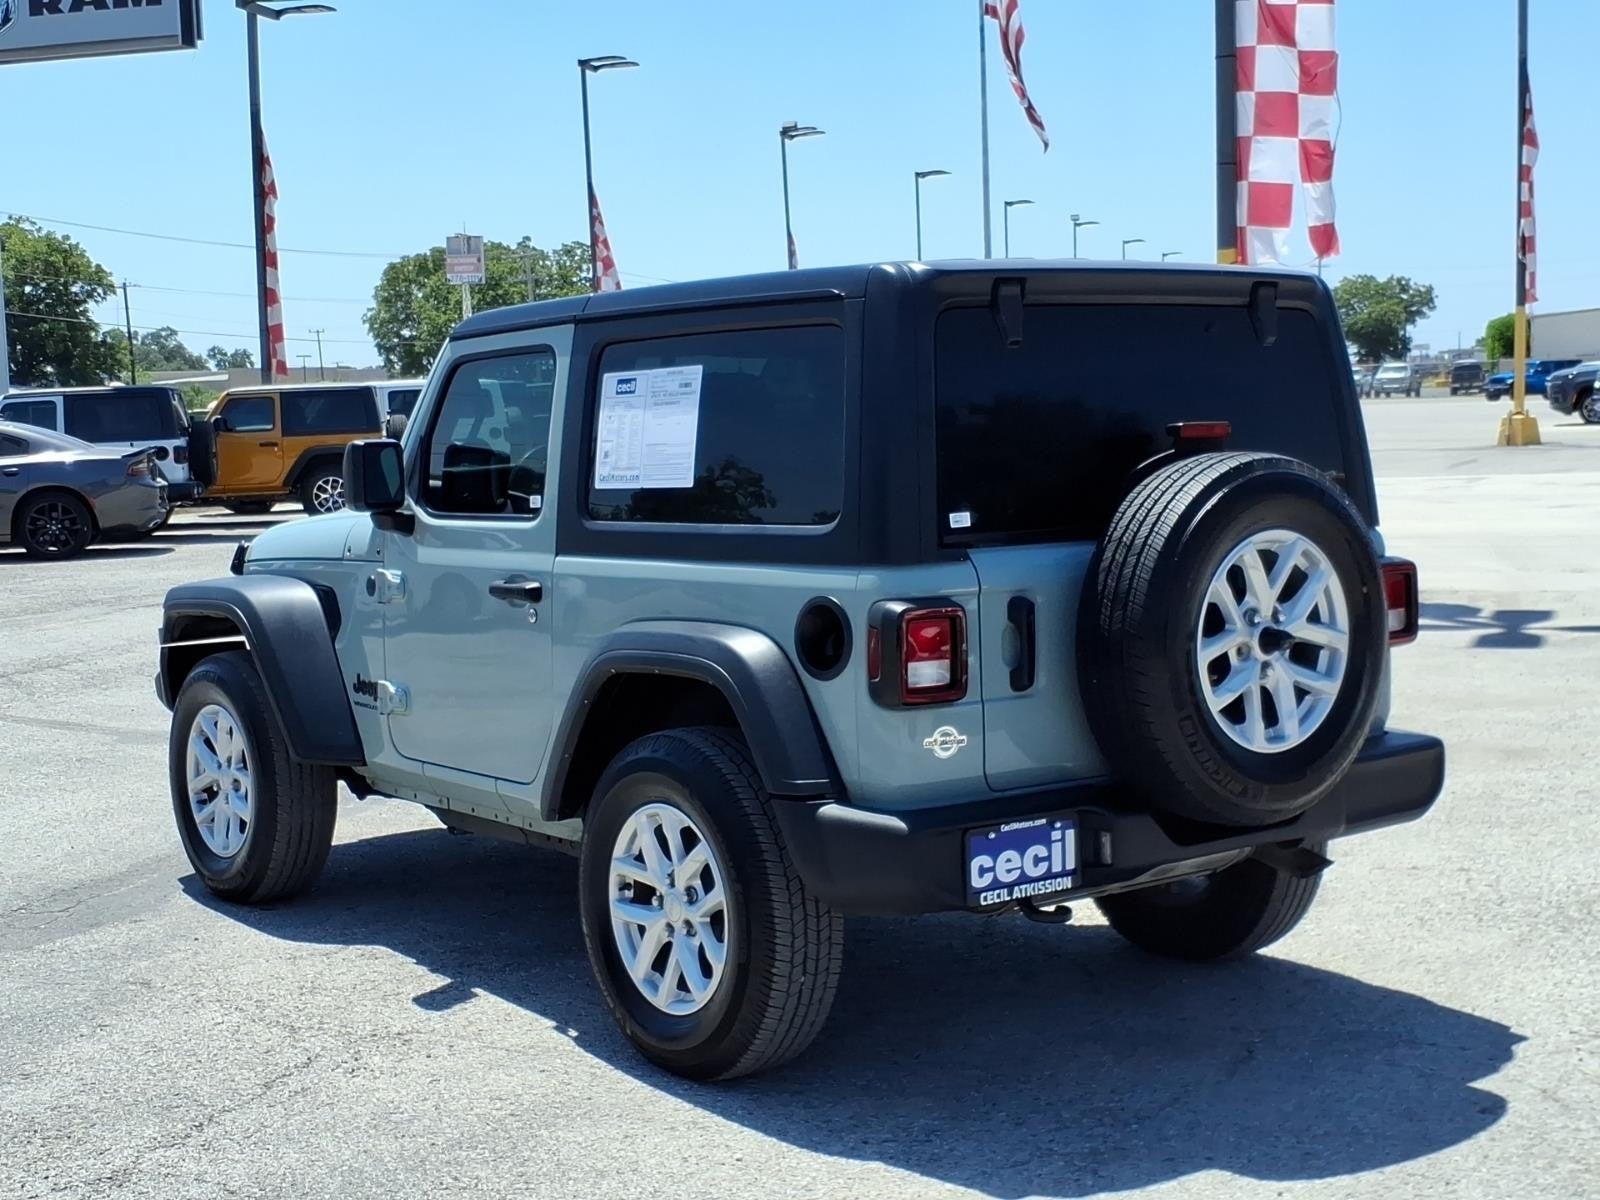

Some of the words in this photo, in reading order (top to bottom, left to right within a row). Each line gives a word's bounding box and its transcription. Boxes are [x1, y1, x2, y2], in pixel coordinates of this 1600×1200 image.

[29, 0, 162, 17] RA
[617, 380, 636, 393] cecil
[1000, 818, 1047, 832] CecilMotors.com
[970, 829, 1076, 889] cecil
[980, 888, 1011, 906] CECIL
[1012, 876, 1072, 899] ATKISSION
